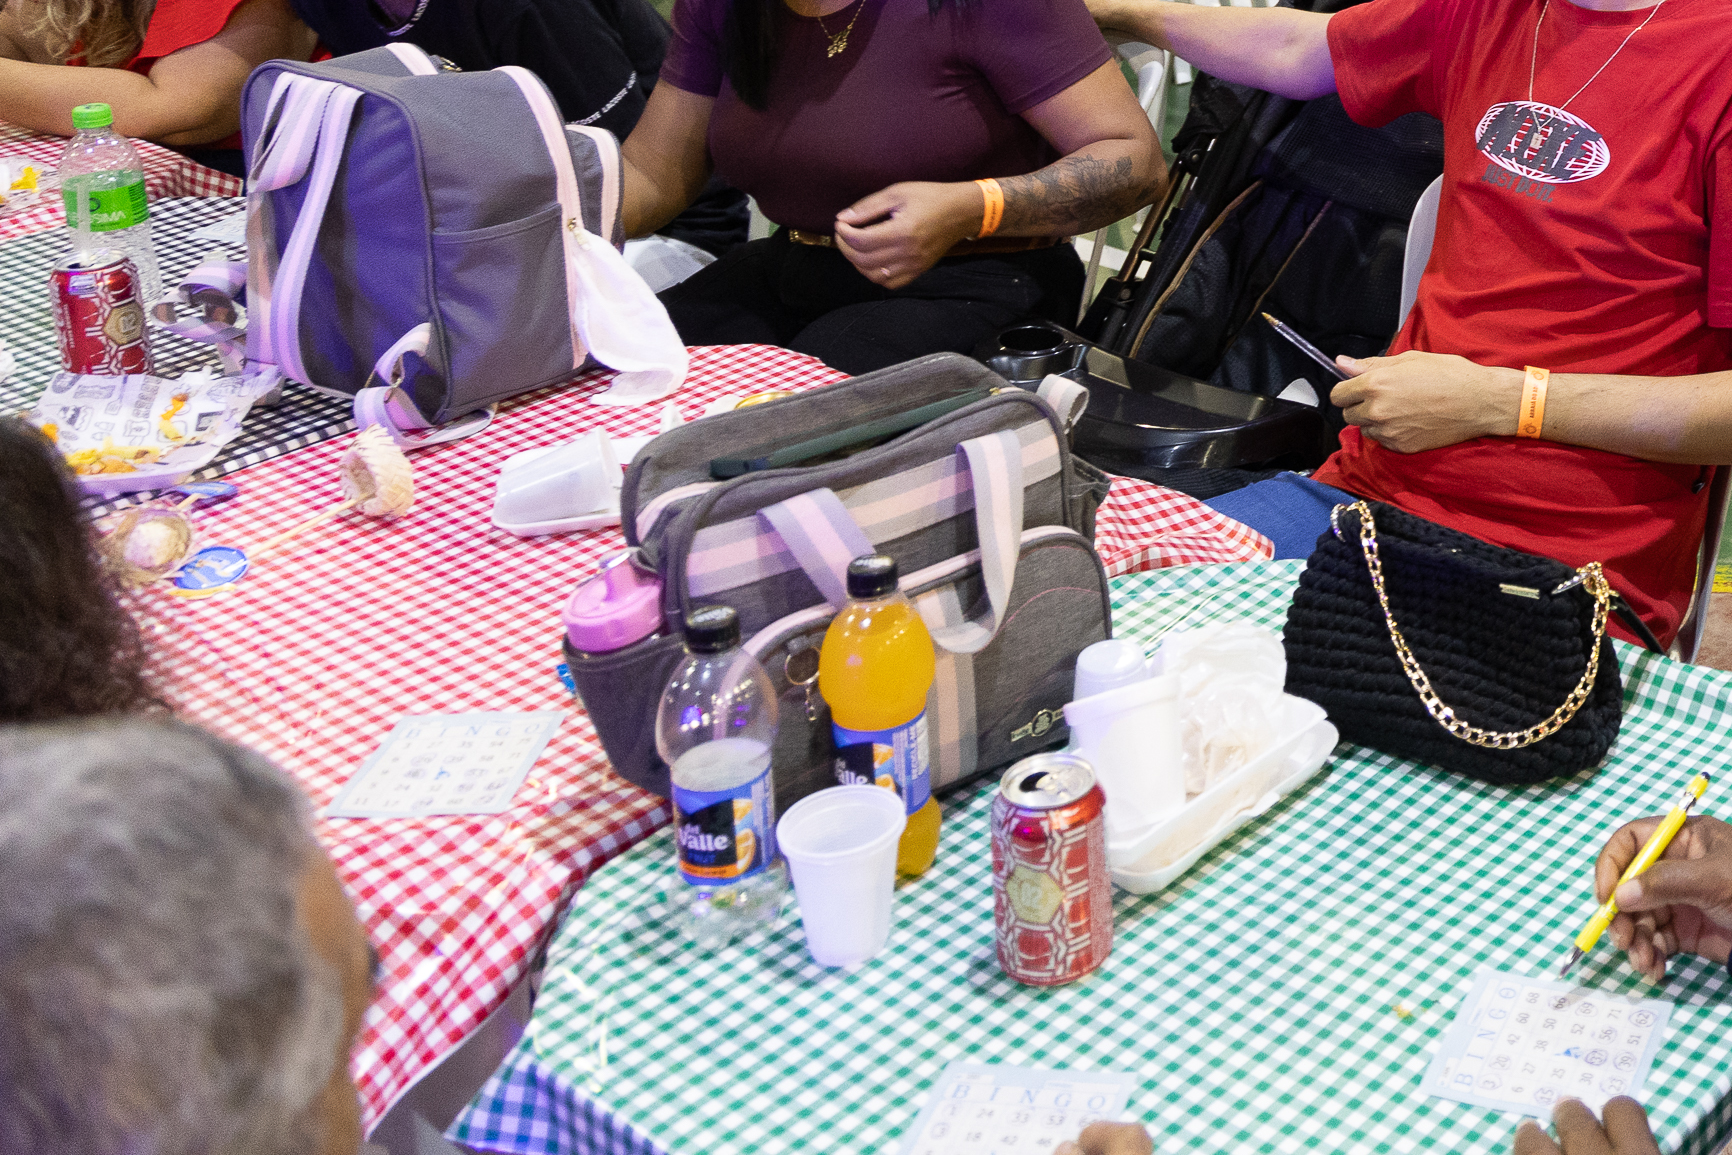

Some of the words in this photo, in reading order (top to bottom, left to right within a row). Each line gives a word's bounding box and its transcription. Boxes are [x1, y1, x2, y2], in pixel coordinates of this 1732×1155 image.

[1476, 102, 1603, 182] NIKE
[1482, 164, 1519, 189] JUST
[1516, 174, 1540, 197] DO
[679, 827, 729, 852] Valle
[1507, 1033, 1521, 1046] 42
[1516, 1012, 1530, 1025] 60
[1525, 992, 1540, 1004] 68
[1521, 1062, 1536, 1075] 27
[1534, 1039, 1550, 1052] 38
[1542, 1017, 1557, 1030] 50
[1626, 1034, 1642, 1046] 51
[1551, 1067, 1566, 1080] 25
[1570, 1023, 1585, 1035] 52
[1578, 1072, 1594, 1086] 30
[1606, 1008, 1622, 1020] 71
[976, 1107, 995, 1119] 24
[1011, 1110, 1031, 1124] 33
[1046, 1114, 1066, 1126] 53
